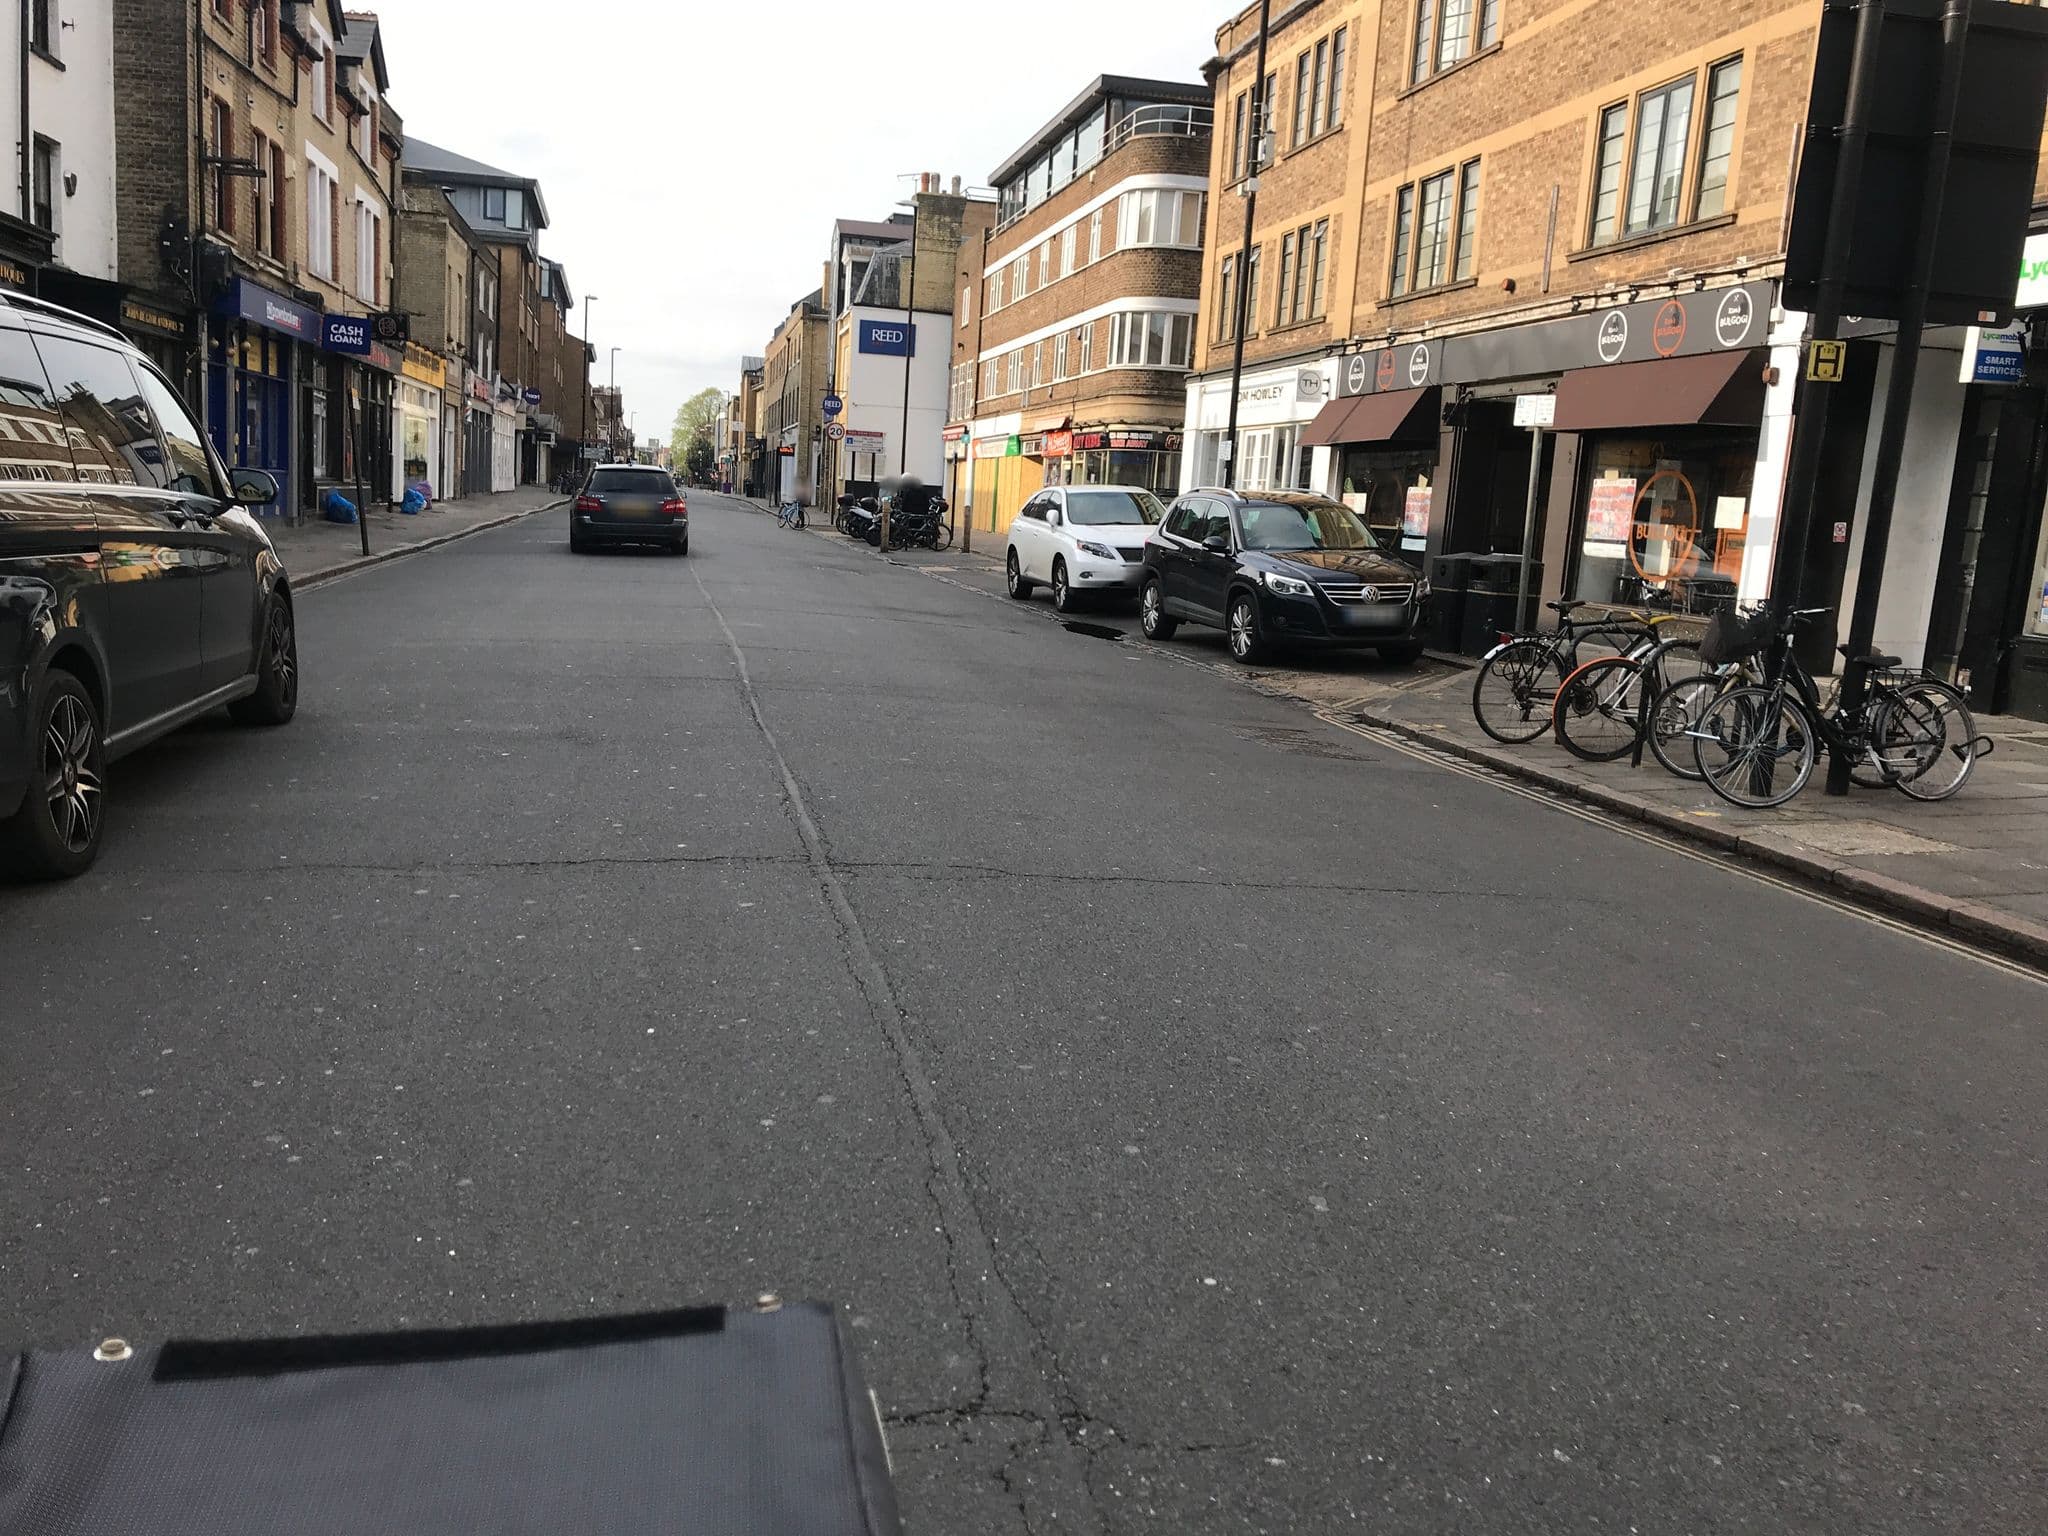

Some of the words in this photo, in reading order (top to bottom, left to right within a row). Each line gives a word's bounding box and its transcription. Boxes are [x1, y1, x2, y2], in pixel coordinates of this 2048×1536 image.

[331, 323, 363, 337] CASH
[872, 328, 903, 343] REED
[330, 333, 363, 346] LOANS
[1984, 355, 2017, 366] SMART
[1976, 364, 2023, 377] SERVICES
[1302, 378, 1318, 388] TH
[1250, 385, 1284, 401] HOWLEY
[825, 400, 841, 408] REED
[830, 427, 843, 436] 20
